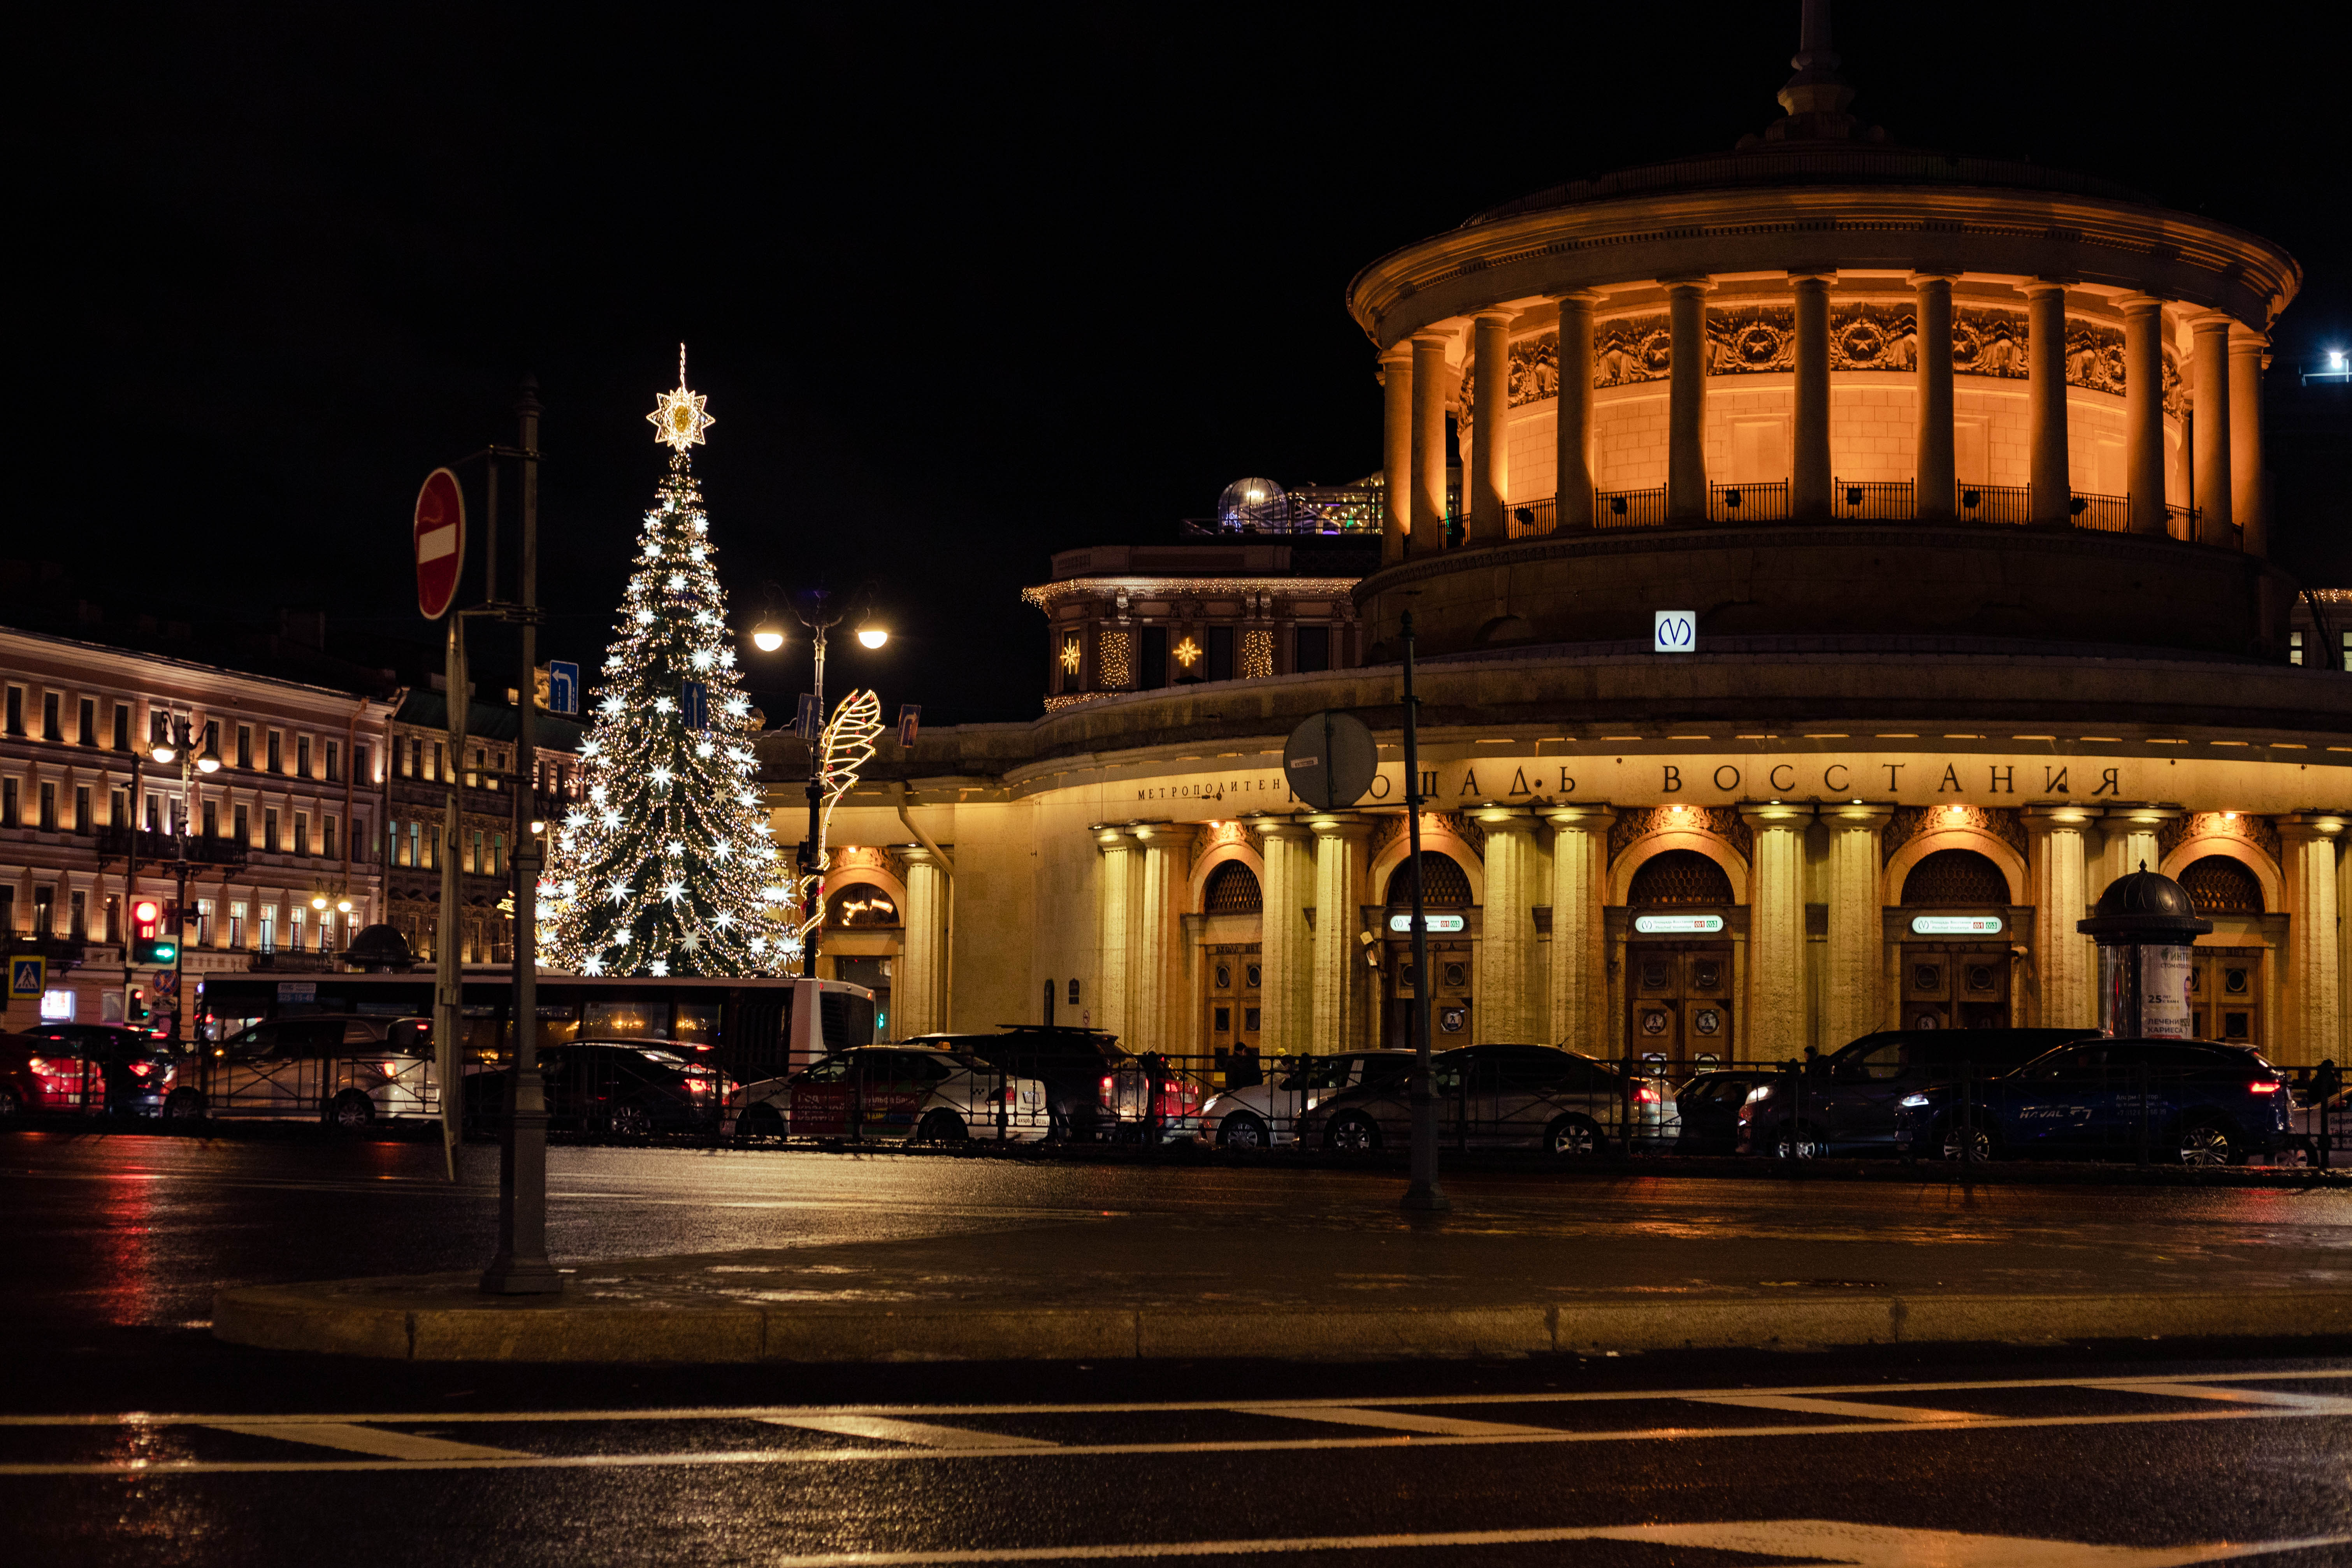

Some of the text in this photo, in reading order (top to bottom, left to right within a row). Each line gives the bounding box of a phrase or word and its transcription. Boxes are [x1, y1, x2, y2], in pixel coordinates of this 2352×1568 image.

[1138, 779, 1280, 801] МЕТРОПОЛИТЕН
[1289, 763, 2119, 802] ОЩАДЬ ВОССТАНИЯ
[2148, 994, 2162, 1003] 25
